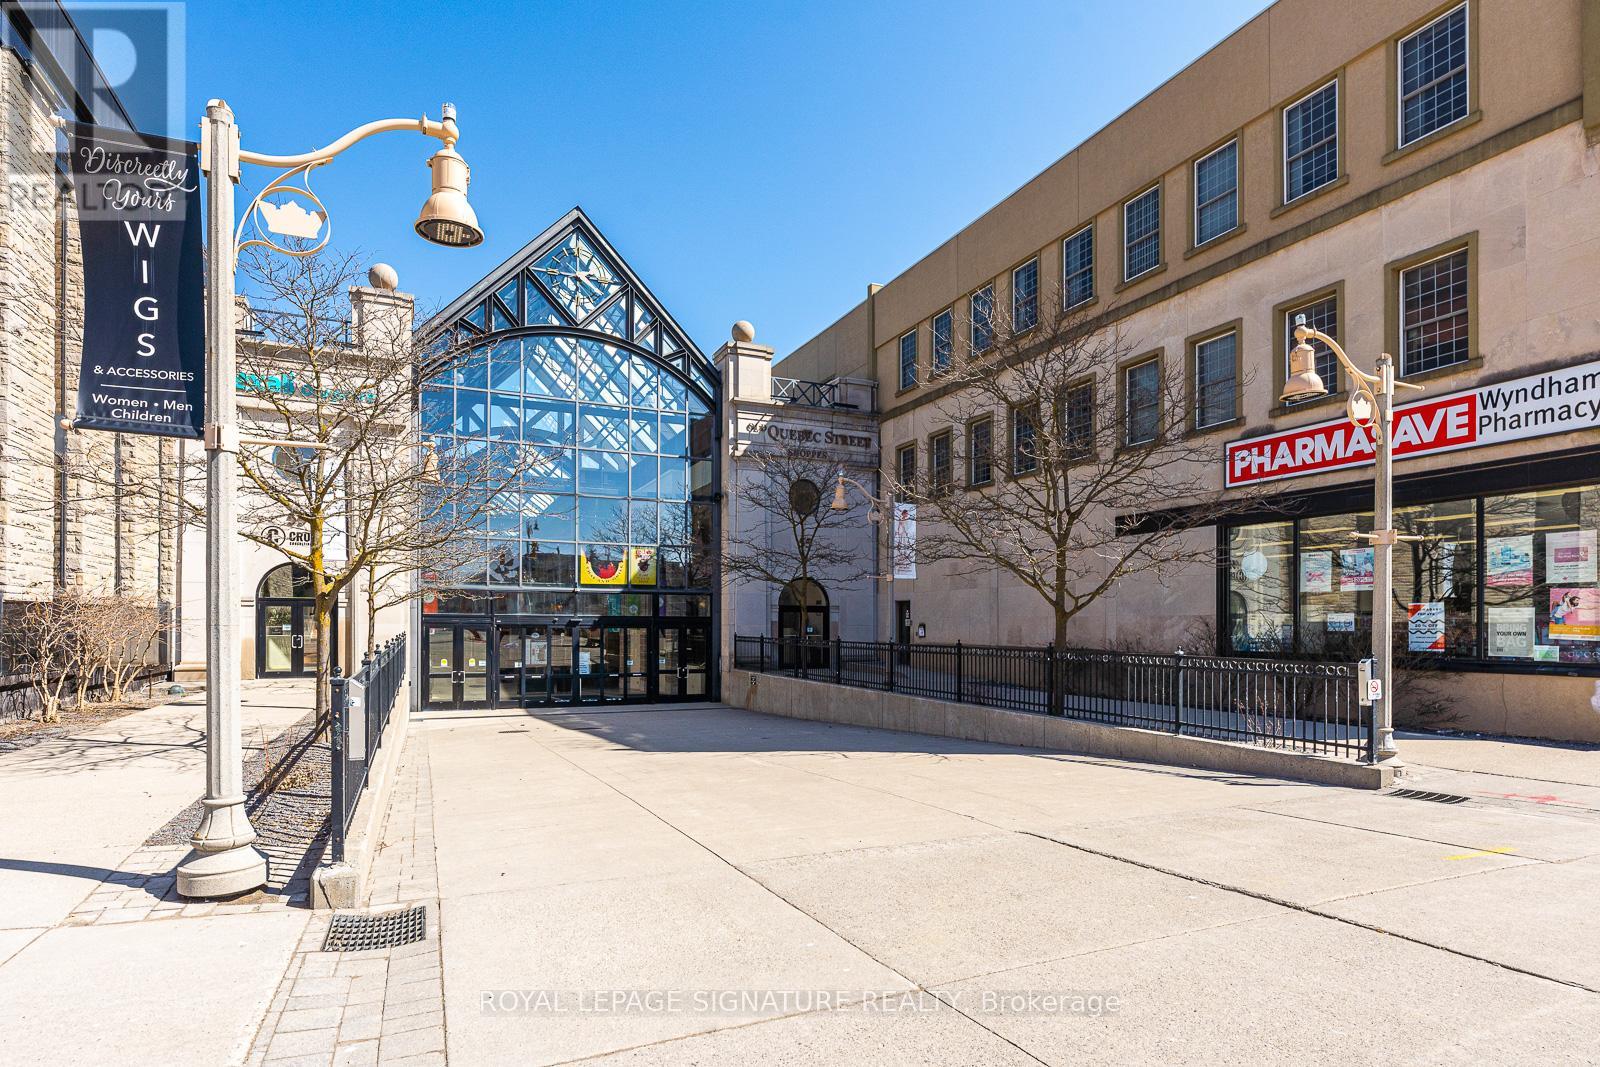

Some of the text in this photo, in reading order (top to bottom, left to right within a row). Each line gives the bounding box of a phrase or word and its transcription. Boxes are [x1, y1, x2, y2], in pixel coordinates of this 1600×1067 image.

[80, 146, 197, 192] Discreetly
[103, 178, 176, 212] Yours
[124, 220, 160, 357] WIGS
[93, 365, 194, 381] & ACCESSORIES
[1479, 372, 1600, 411] Wyndham
[92, 393, 193, 411] Women Men
[111, 408, 172, 423] Children
[1479, 400, 1600, 435] Pharmacy
[824, 430, 872, 449] STREET
[289, 531, 310, 542] CRO
[1496, 623, 1527, 632] BRING
[1496, 638, 1527, 648] BAG
